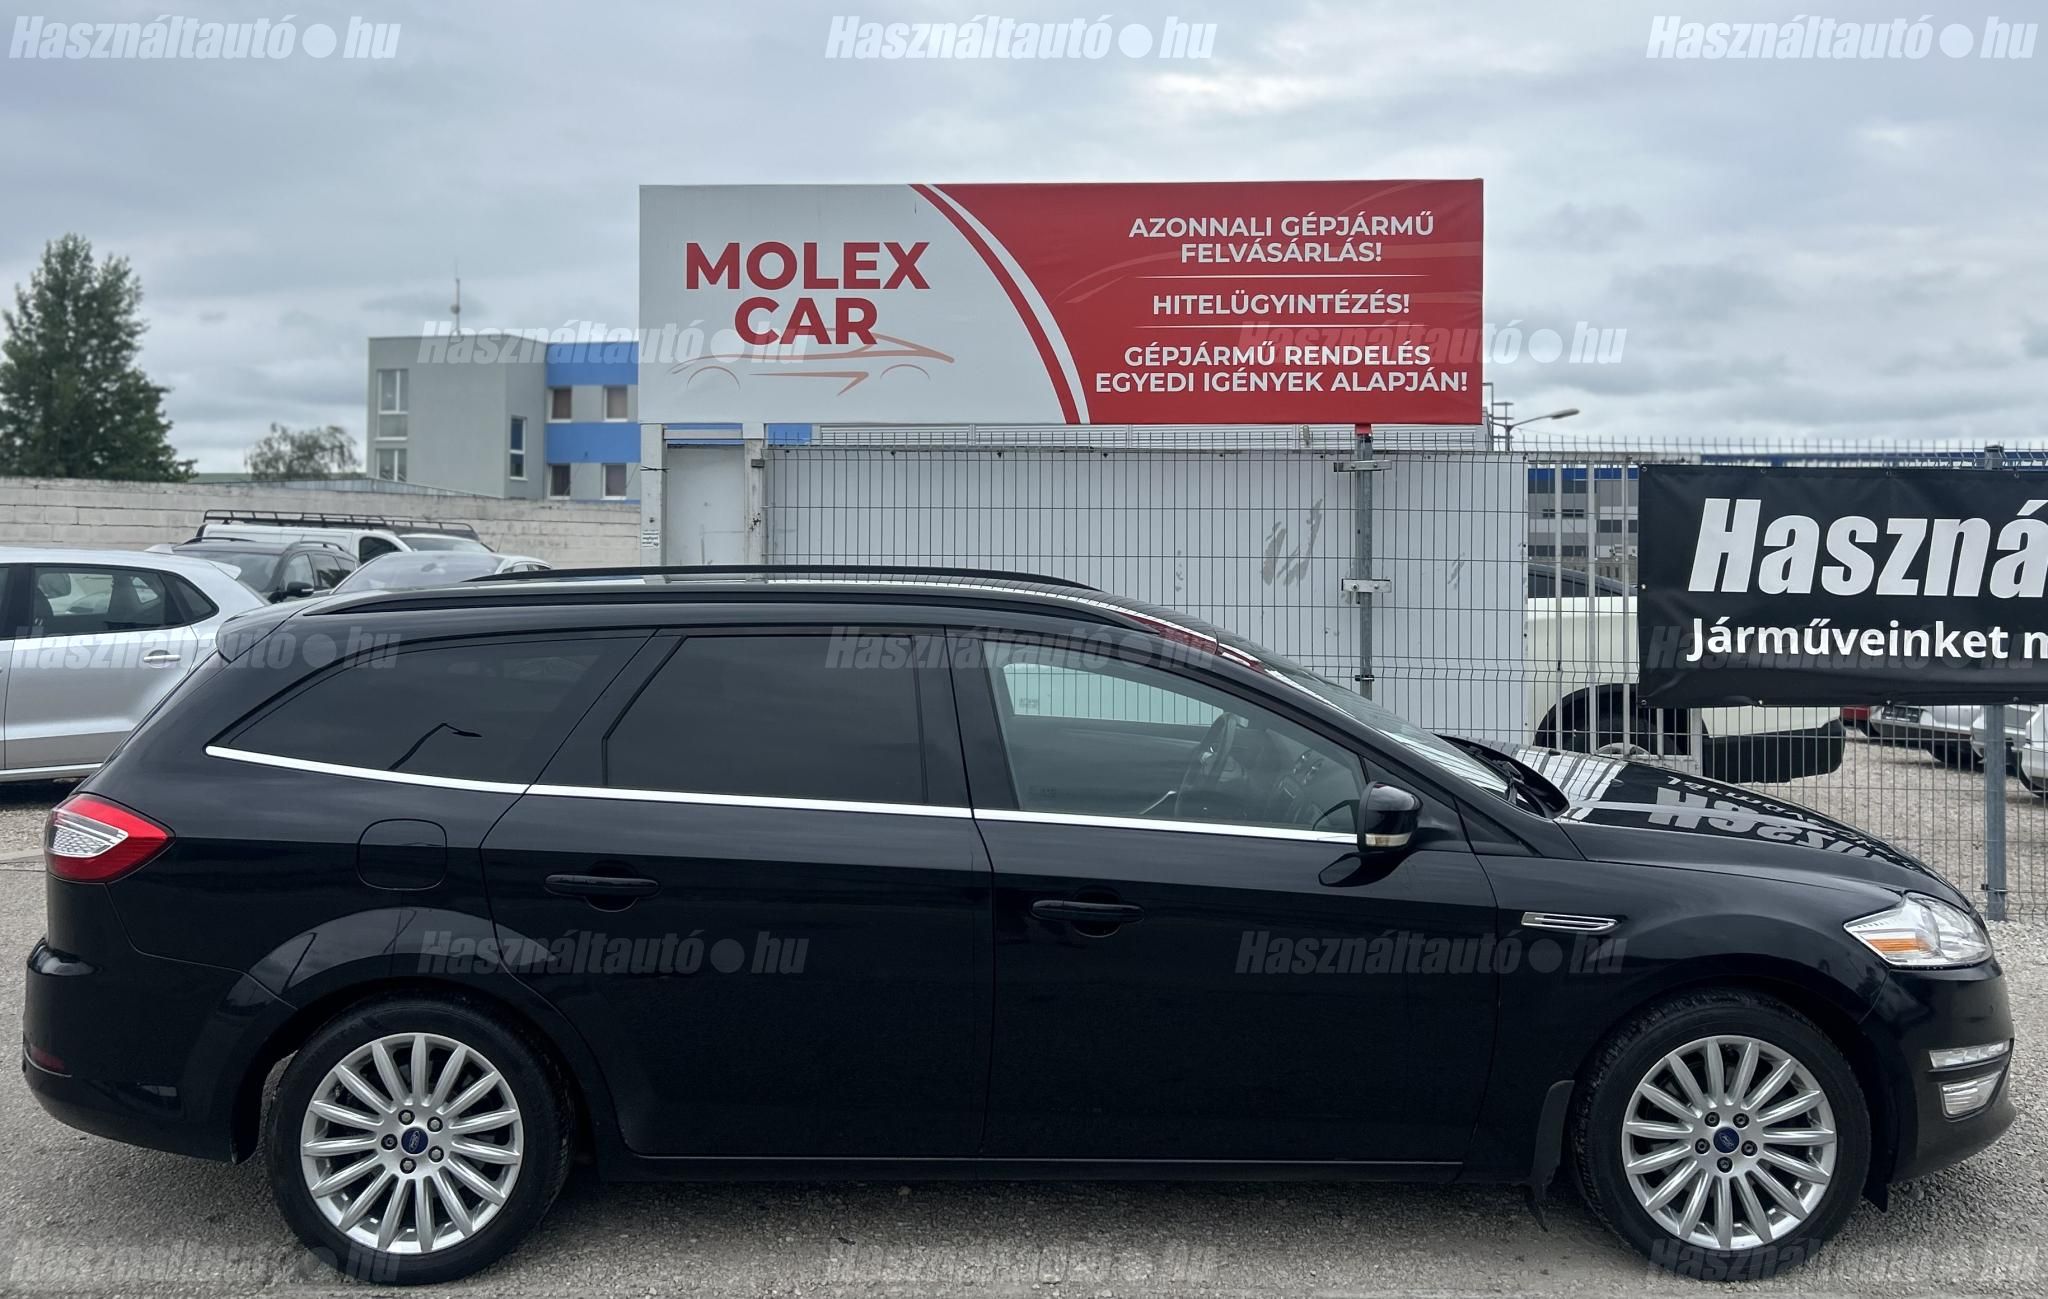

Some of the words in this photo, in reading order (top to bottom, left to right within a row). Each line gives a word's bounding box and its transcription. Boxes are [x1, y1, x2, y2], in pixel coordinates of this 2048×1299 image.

[1129, 217, 1272, 239] AZONNALI
[1281, 211, 1434, 237] GÉPJÁRMŰ
[1181, 238, 1382, 263] FELVÁSÁRLÁS!
[686, 242, 931, 290] MOLEX
[1153, 289, 1410, 315] HITELÜGYINTÉZÉS!
[734, 297, 878, 345] CAR
[1124, 341, 1276, 367] GÉPJÁRMŰ
[1285, 340, 1431, 366] RENDELÉS
[1096, 372, 1194, 393] EGYEDI
[1204, 366, 1323, 392] IGÉNYEK
[1331, 364, 1468, 392] ALAPJÁN!
[1686, 616, 2009, 662] Járműveinket
